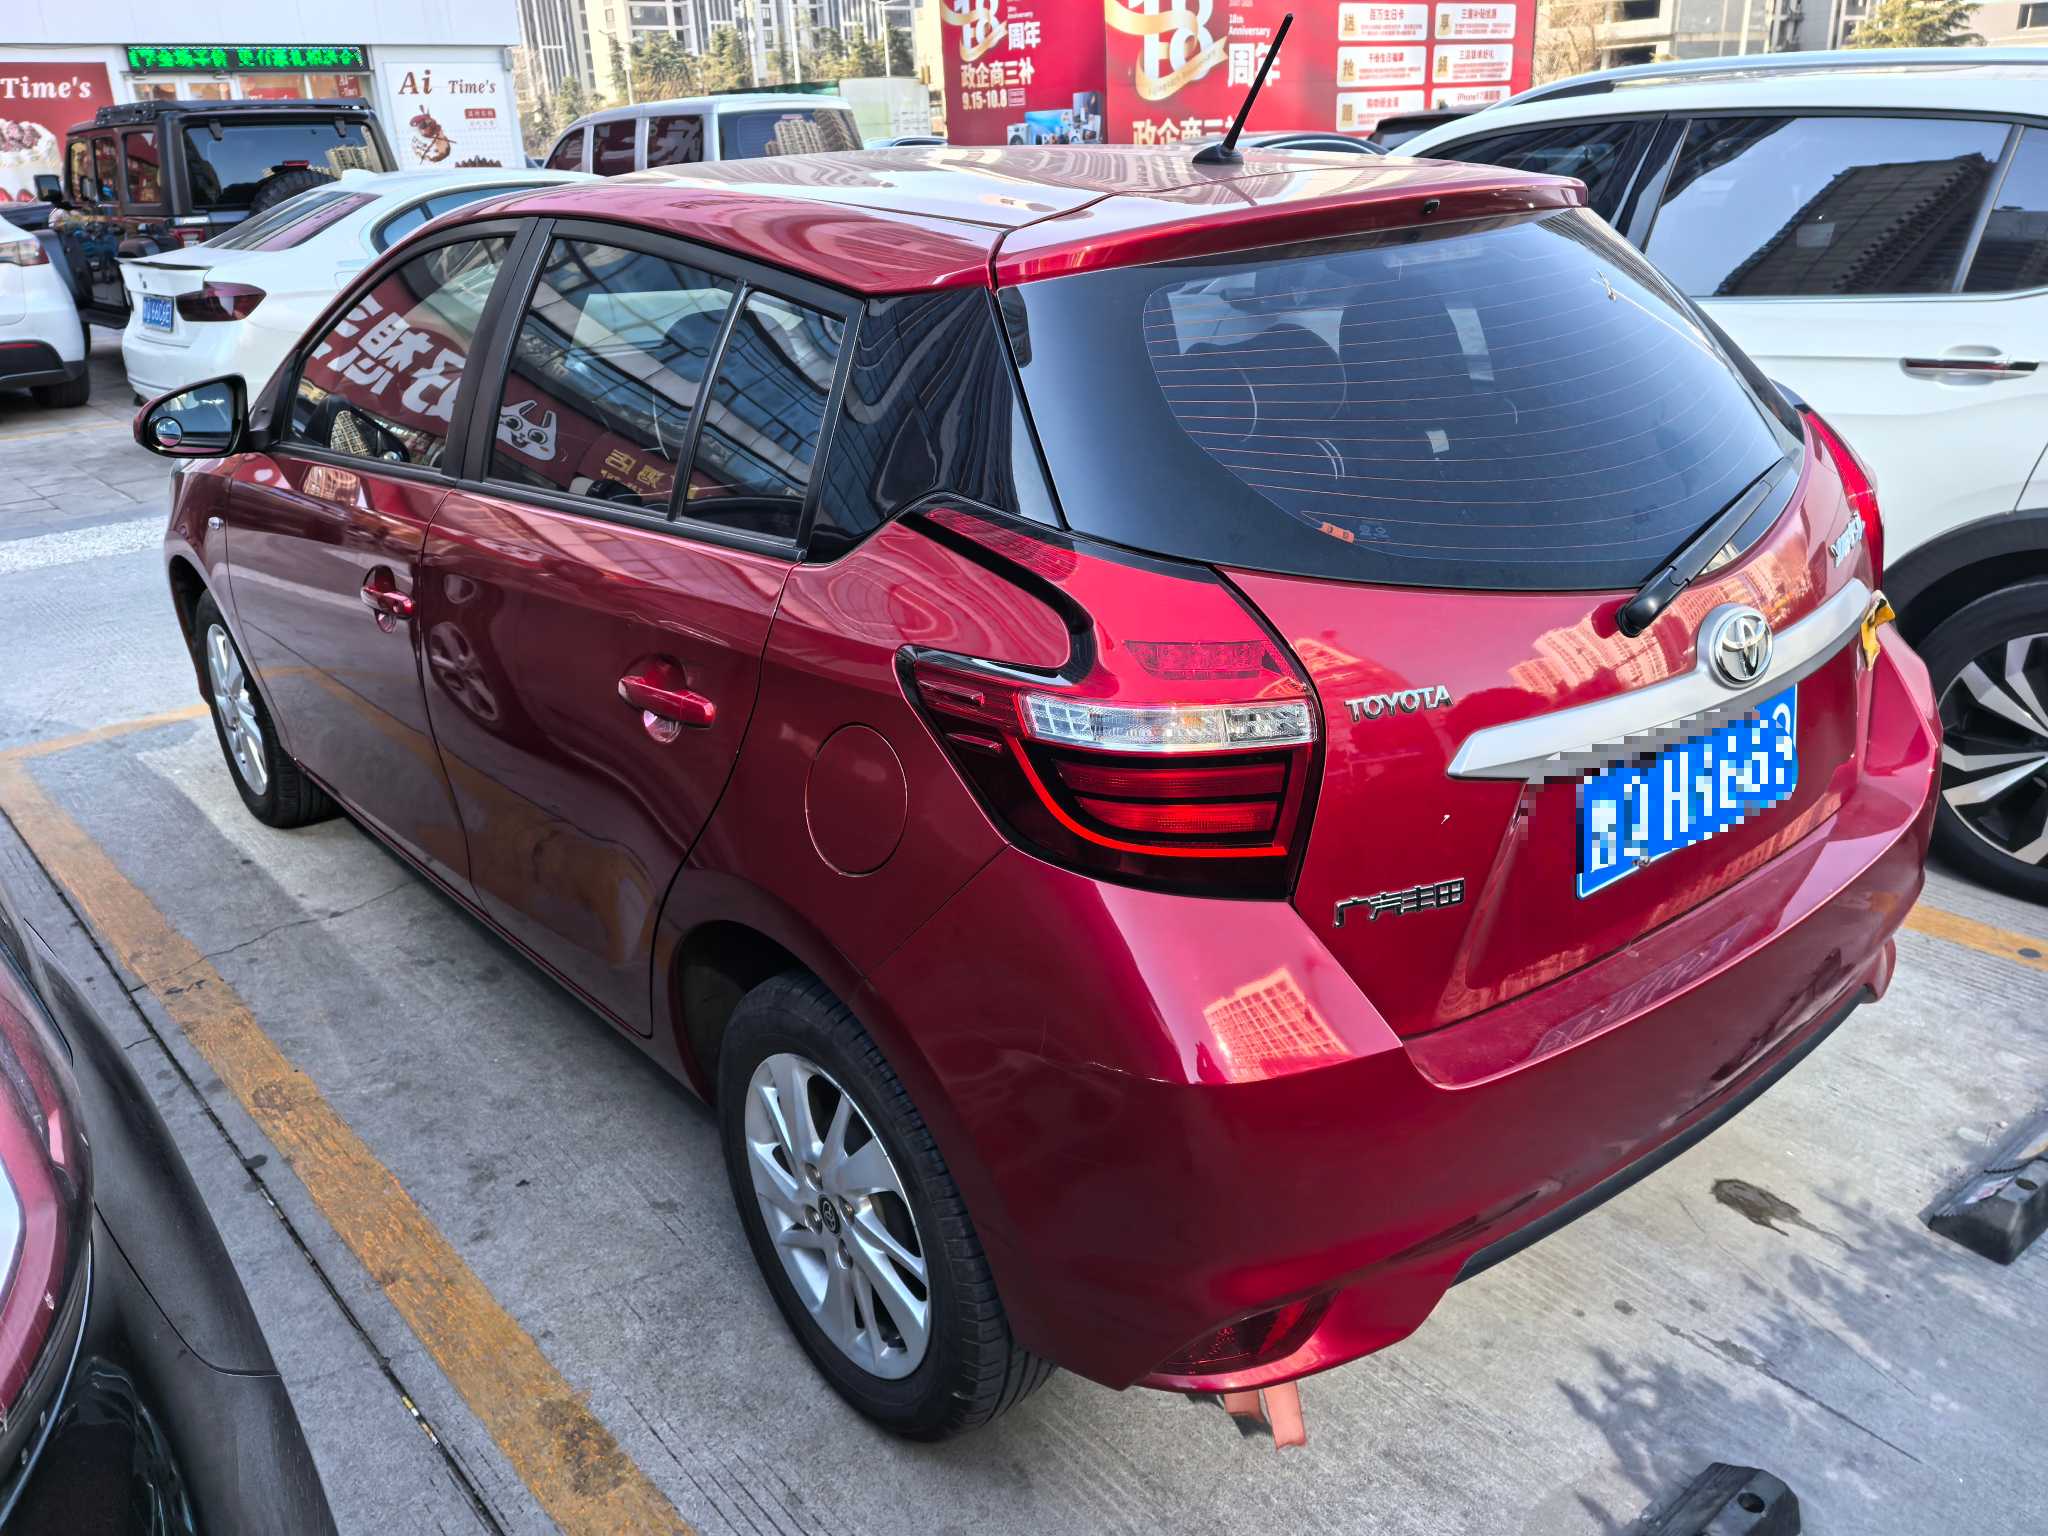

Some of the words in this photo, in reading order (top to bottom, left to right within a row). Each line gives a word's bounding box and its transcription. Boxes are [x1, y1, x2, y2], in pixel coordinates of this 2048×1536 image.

[1007, 21, 1041, 50] 周年
[1228, 26, 1271, 38] Anniversary
[398, 69, 432, 95] Ai
[448, 79, 497, 94] Time's
[961, 57, 1035, 88] 政企商三补
[0, 76, 92, 98] Time's
[962, 88, 1007, 110] 9.15-10.8
[1344, 685, 1454, 722] TOYOTA
[1333, 877, 1466, 928] 广汽丰田
